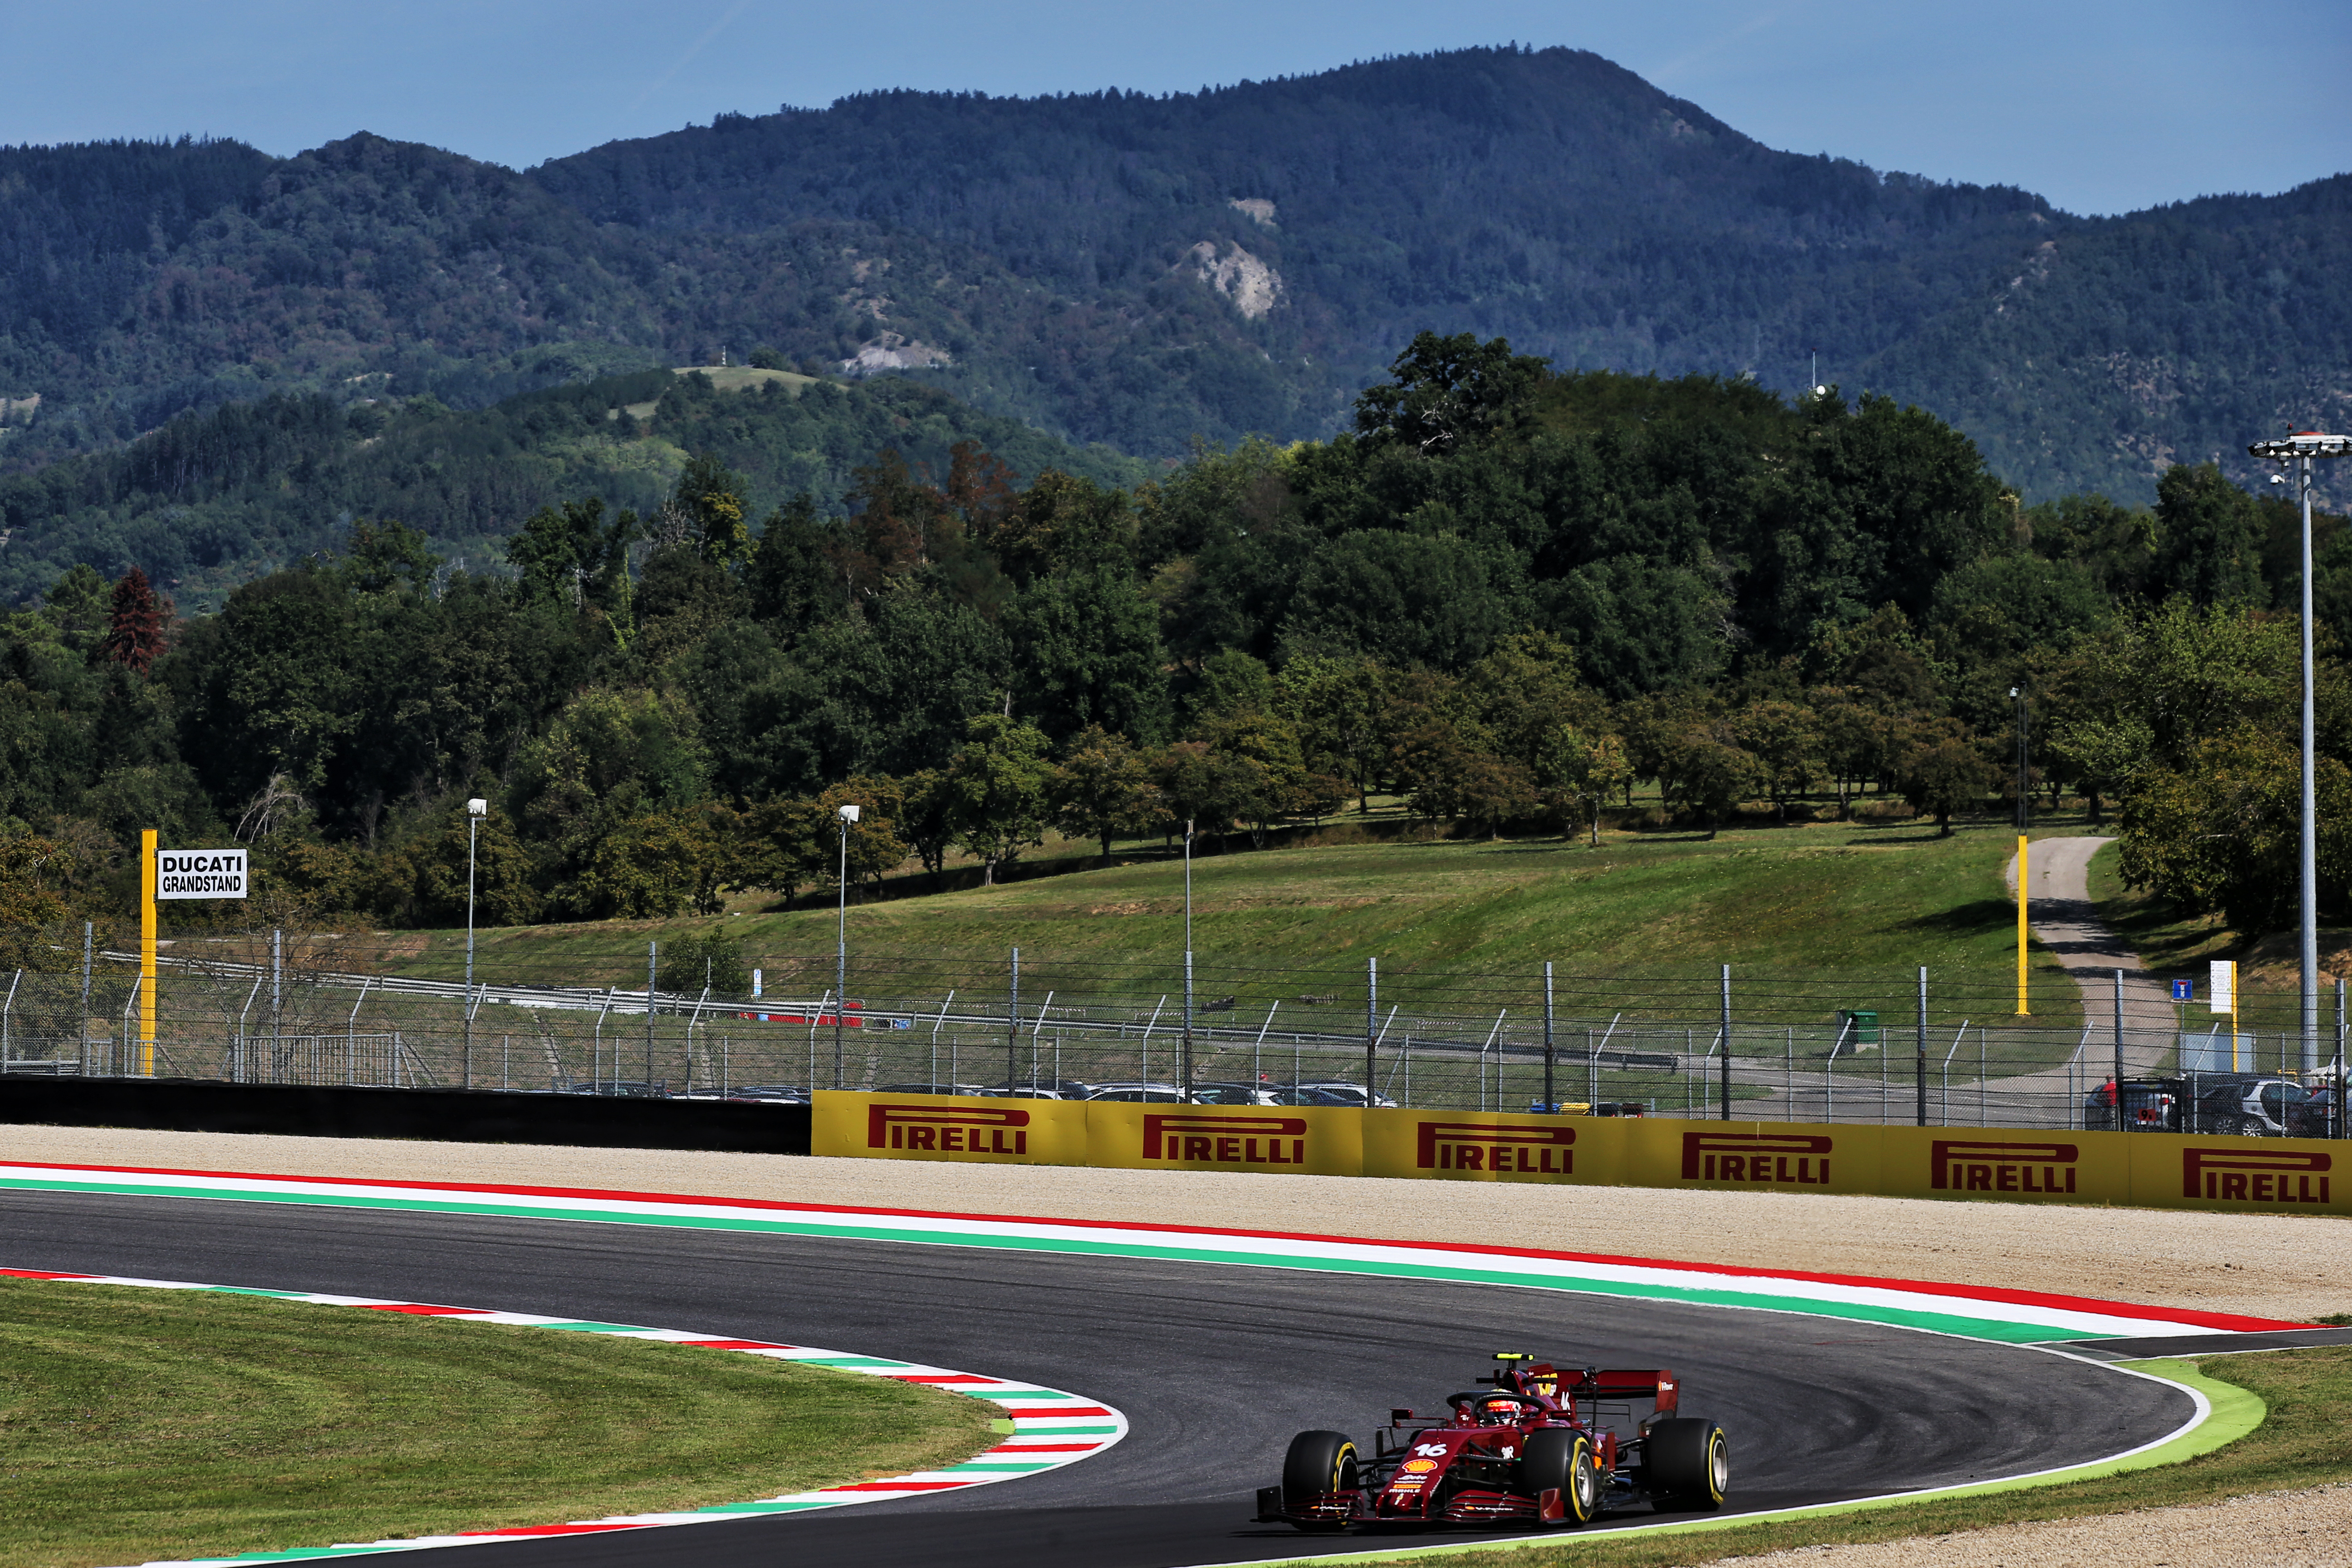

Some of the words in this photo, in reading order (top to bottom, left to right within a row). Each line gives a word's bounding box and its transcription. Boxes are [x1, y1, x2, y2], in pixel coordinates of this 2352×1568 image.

[163, 857, 242, 872] DUCATI
[163, 876, 241, 892] GRANDSTAND
[867, 1103, 1030, 1155] PIRELLI
[1142, 1114, 1307, 1164] PIRELLI
[1416, 1122, 1576, 1174] PIRELLI
[1681, 1132, 1833, 1184] PIRELLI
[1931, 1140, 2079, 1193] PIRELLI
[2182, 1147, 2332, 1203] PIRELLI
[1414, 1443, 1447, 1457] 16
